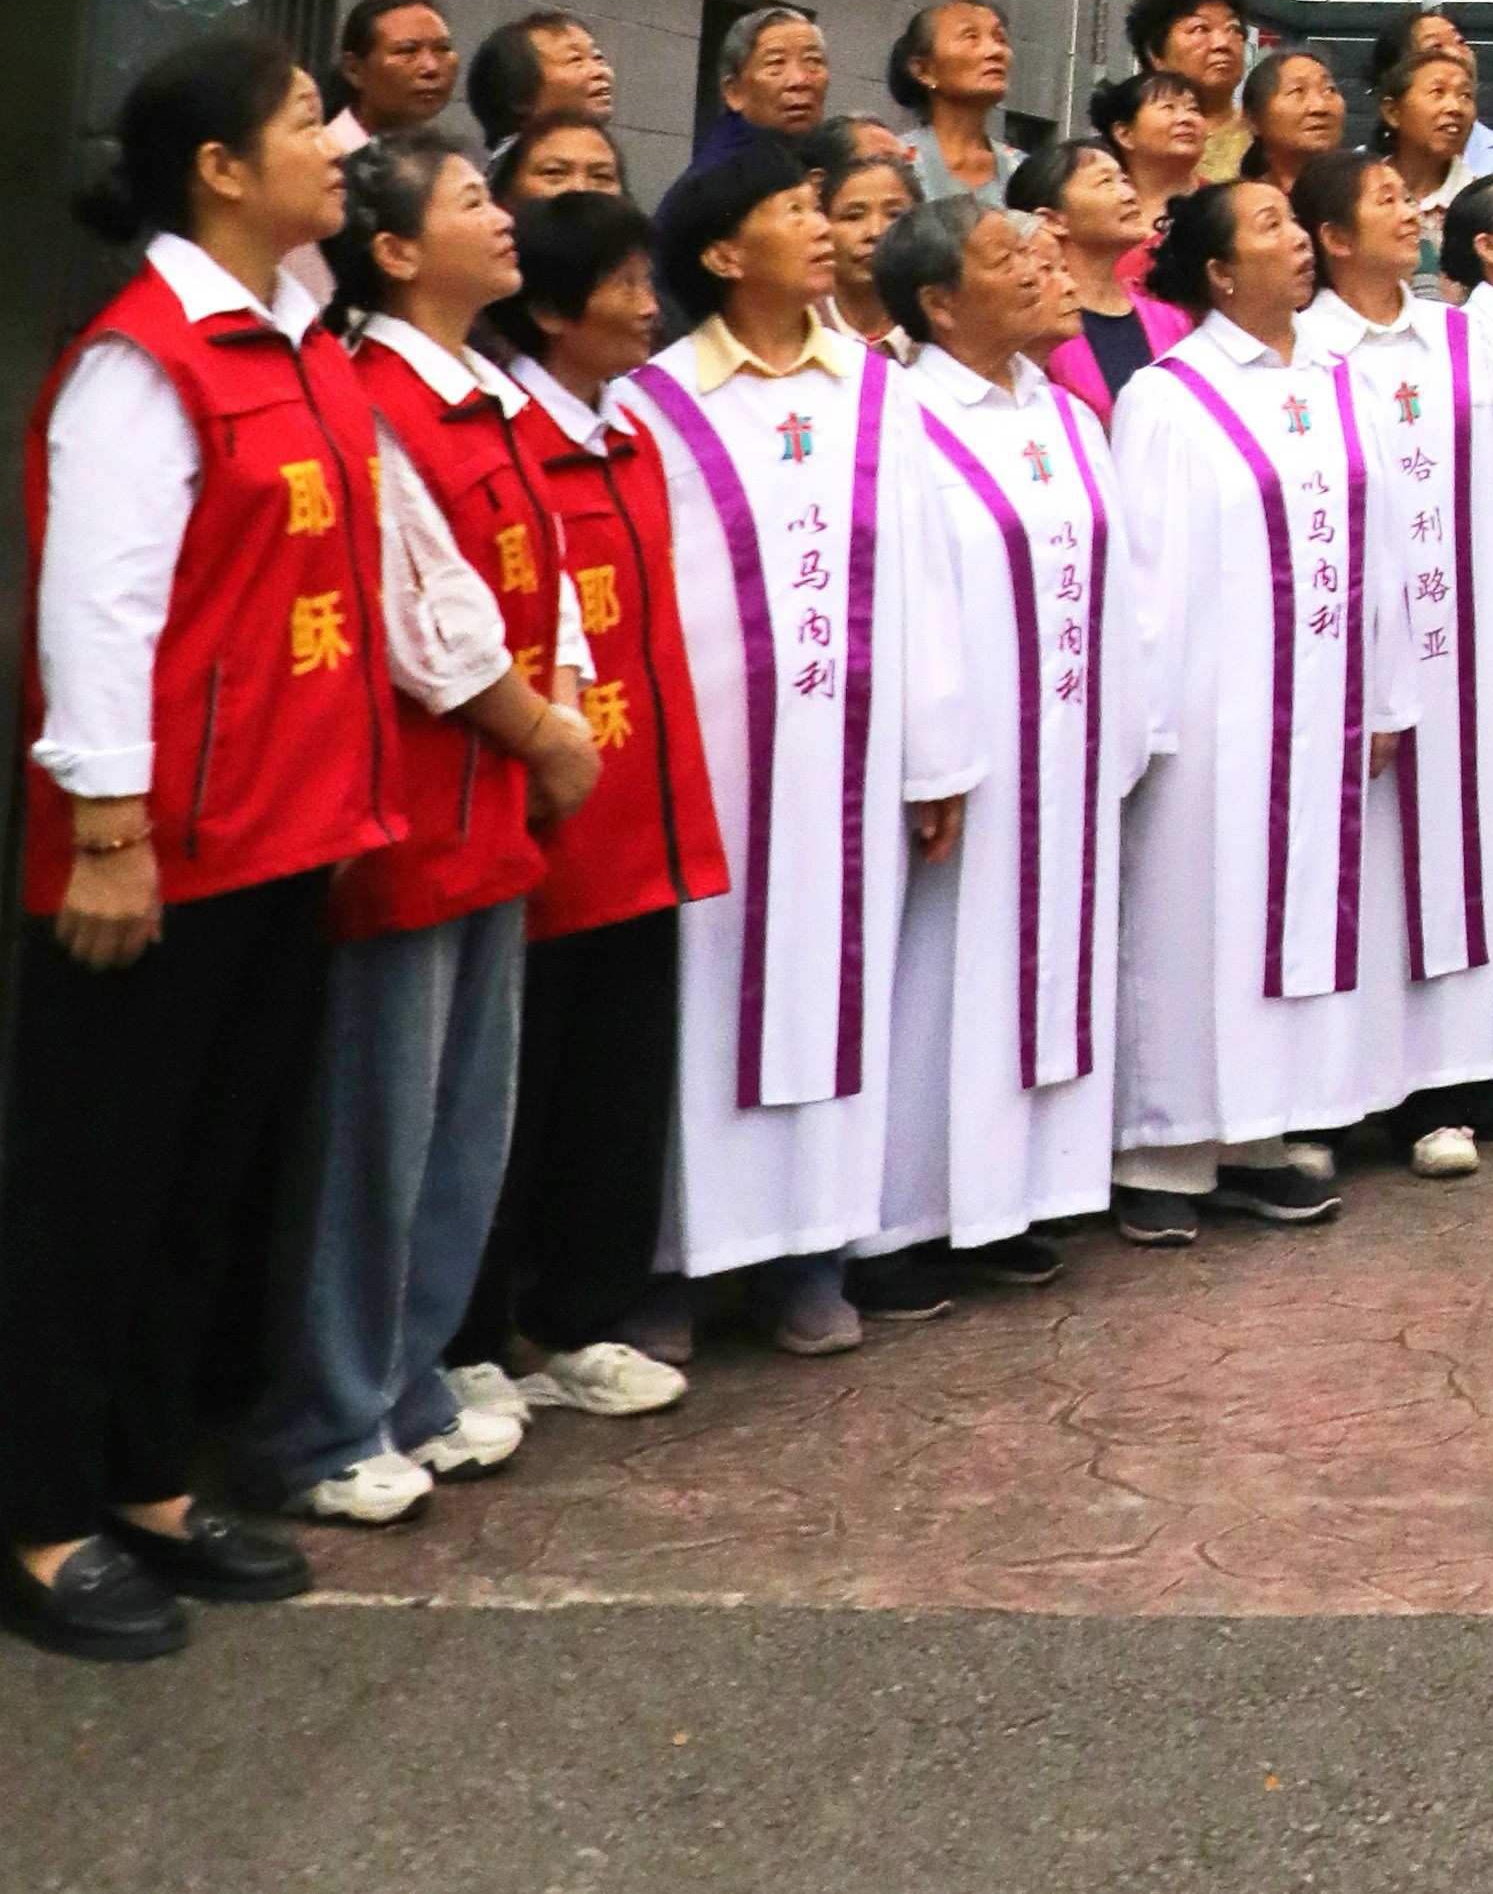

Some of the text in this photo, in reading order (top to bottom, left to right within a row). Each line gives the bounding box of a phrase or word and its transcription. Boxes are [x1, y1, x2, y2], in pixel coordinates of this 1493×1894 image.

[279, 459, 353, 676] 耶稣
[787, 503, 836, 698] 以马内利
[1050, 520, 1084, 703] 以马内利
[1302, 470, 1342, 639] 以马内利
[1401, 446, 1451, 661] 哈利路亚
[577, 564, 633, 749] 耶稣
